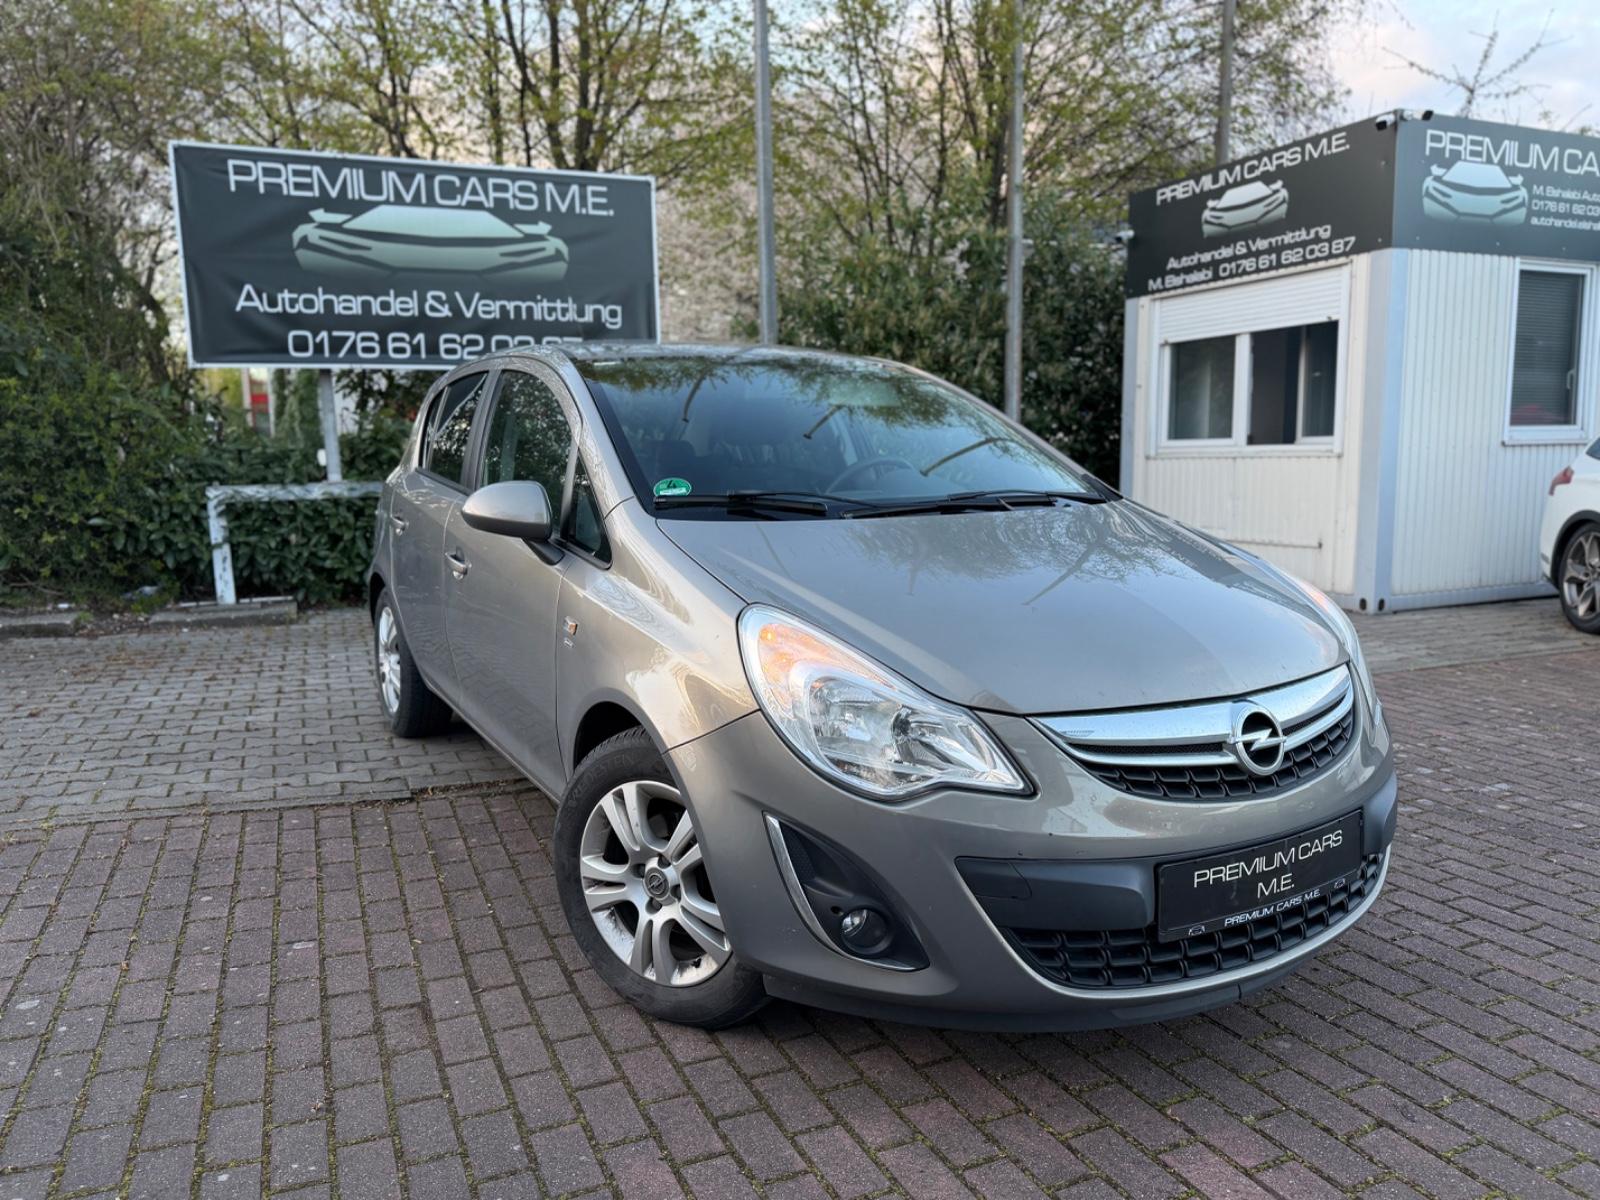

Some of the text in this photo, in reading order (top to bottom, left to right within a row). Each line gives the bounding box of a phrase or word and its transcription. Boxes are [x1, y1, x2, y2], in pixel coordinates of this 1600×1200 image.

[1156, 131, 1350, 206] PREMIUM CARS M.E.
[1425, 129, 1559, 172] PREMIUM
[227, 158, 614, 216] PREMIUM CARS M.E.
[1531, 199, 1557, 212] 0176
[1558, 202, 1570, 213] 61
[1166, 224, 1332, 271] Autohandel & Vermittlung
[1219, 257, 1257, 278] 0176
[1258, 253, 1277, 269] 61
[1281, 247, 1304, 265] 62
[1305, 242, 1330, 260] 03
[1331, 236, 1356, 254] 87
[235, 284, 623, 329] Autohandel & Vermittlung
[288, 330, 380, 359] 0176
[387, 331, 426, 360] 61
[439, 333, 484, 360] 62
[1194, 830, 1343, 888] PREMIUM CARS
[1257, 873, 1294, 899] M.E.
[1224, 905, 1274, 927] PREMIUM
[1276, 896, 1302, 915] CARS
